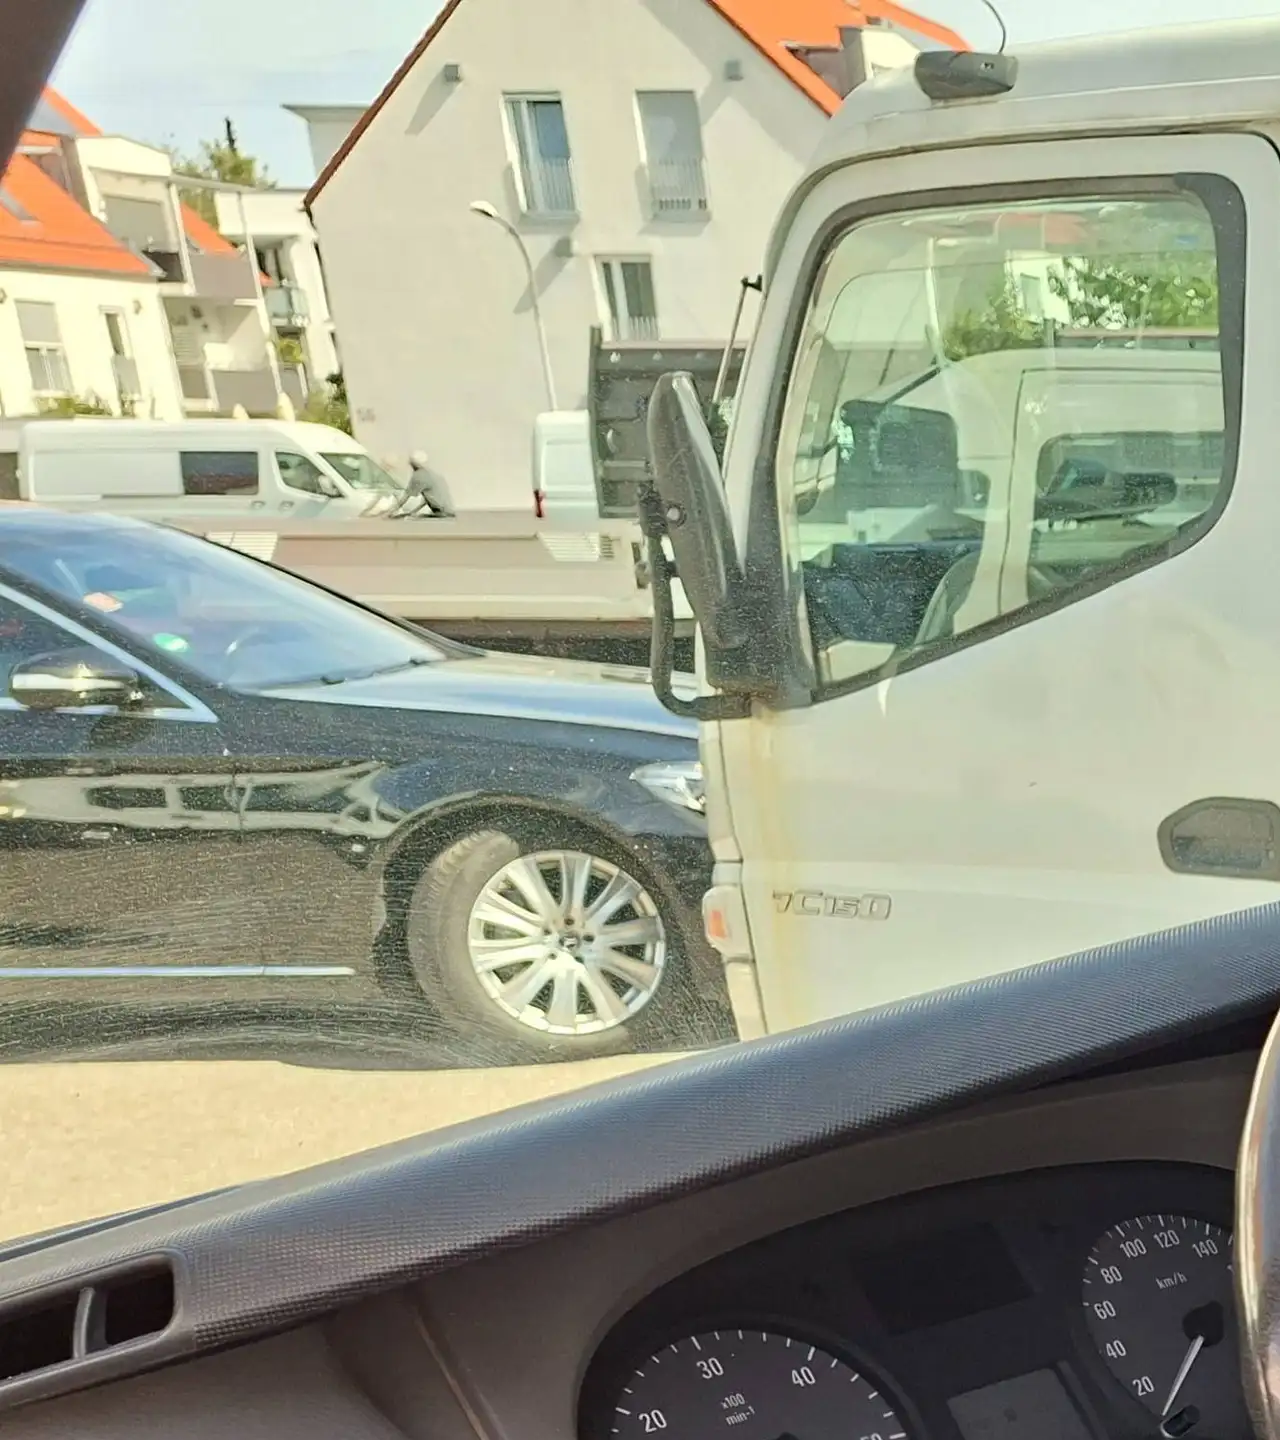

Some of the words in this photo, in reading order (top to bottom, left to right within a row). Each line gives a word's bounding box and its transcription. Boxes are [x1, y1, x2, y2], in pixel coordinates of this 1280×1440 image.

[1119, 1237, 1147, 1260] 100
[1154, 1229, 1180, 1249] 120
[1192, 1239, 1218, 1259] 140
[1100, 1265, 1123, 1285] 80
[1156, 1271, 1188, 1290] km/h
[1094, 1300, 1117, 1320] 60
[1105, 1339, 1127, 1359] 40
[696, 1357, 724, 1380] 30
[791, 1366, 816, 1388] 40
[1132, 1375, 1155, 1397] 20
[638, 1409, 668, 1433] 20
